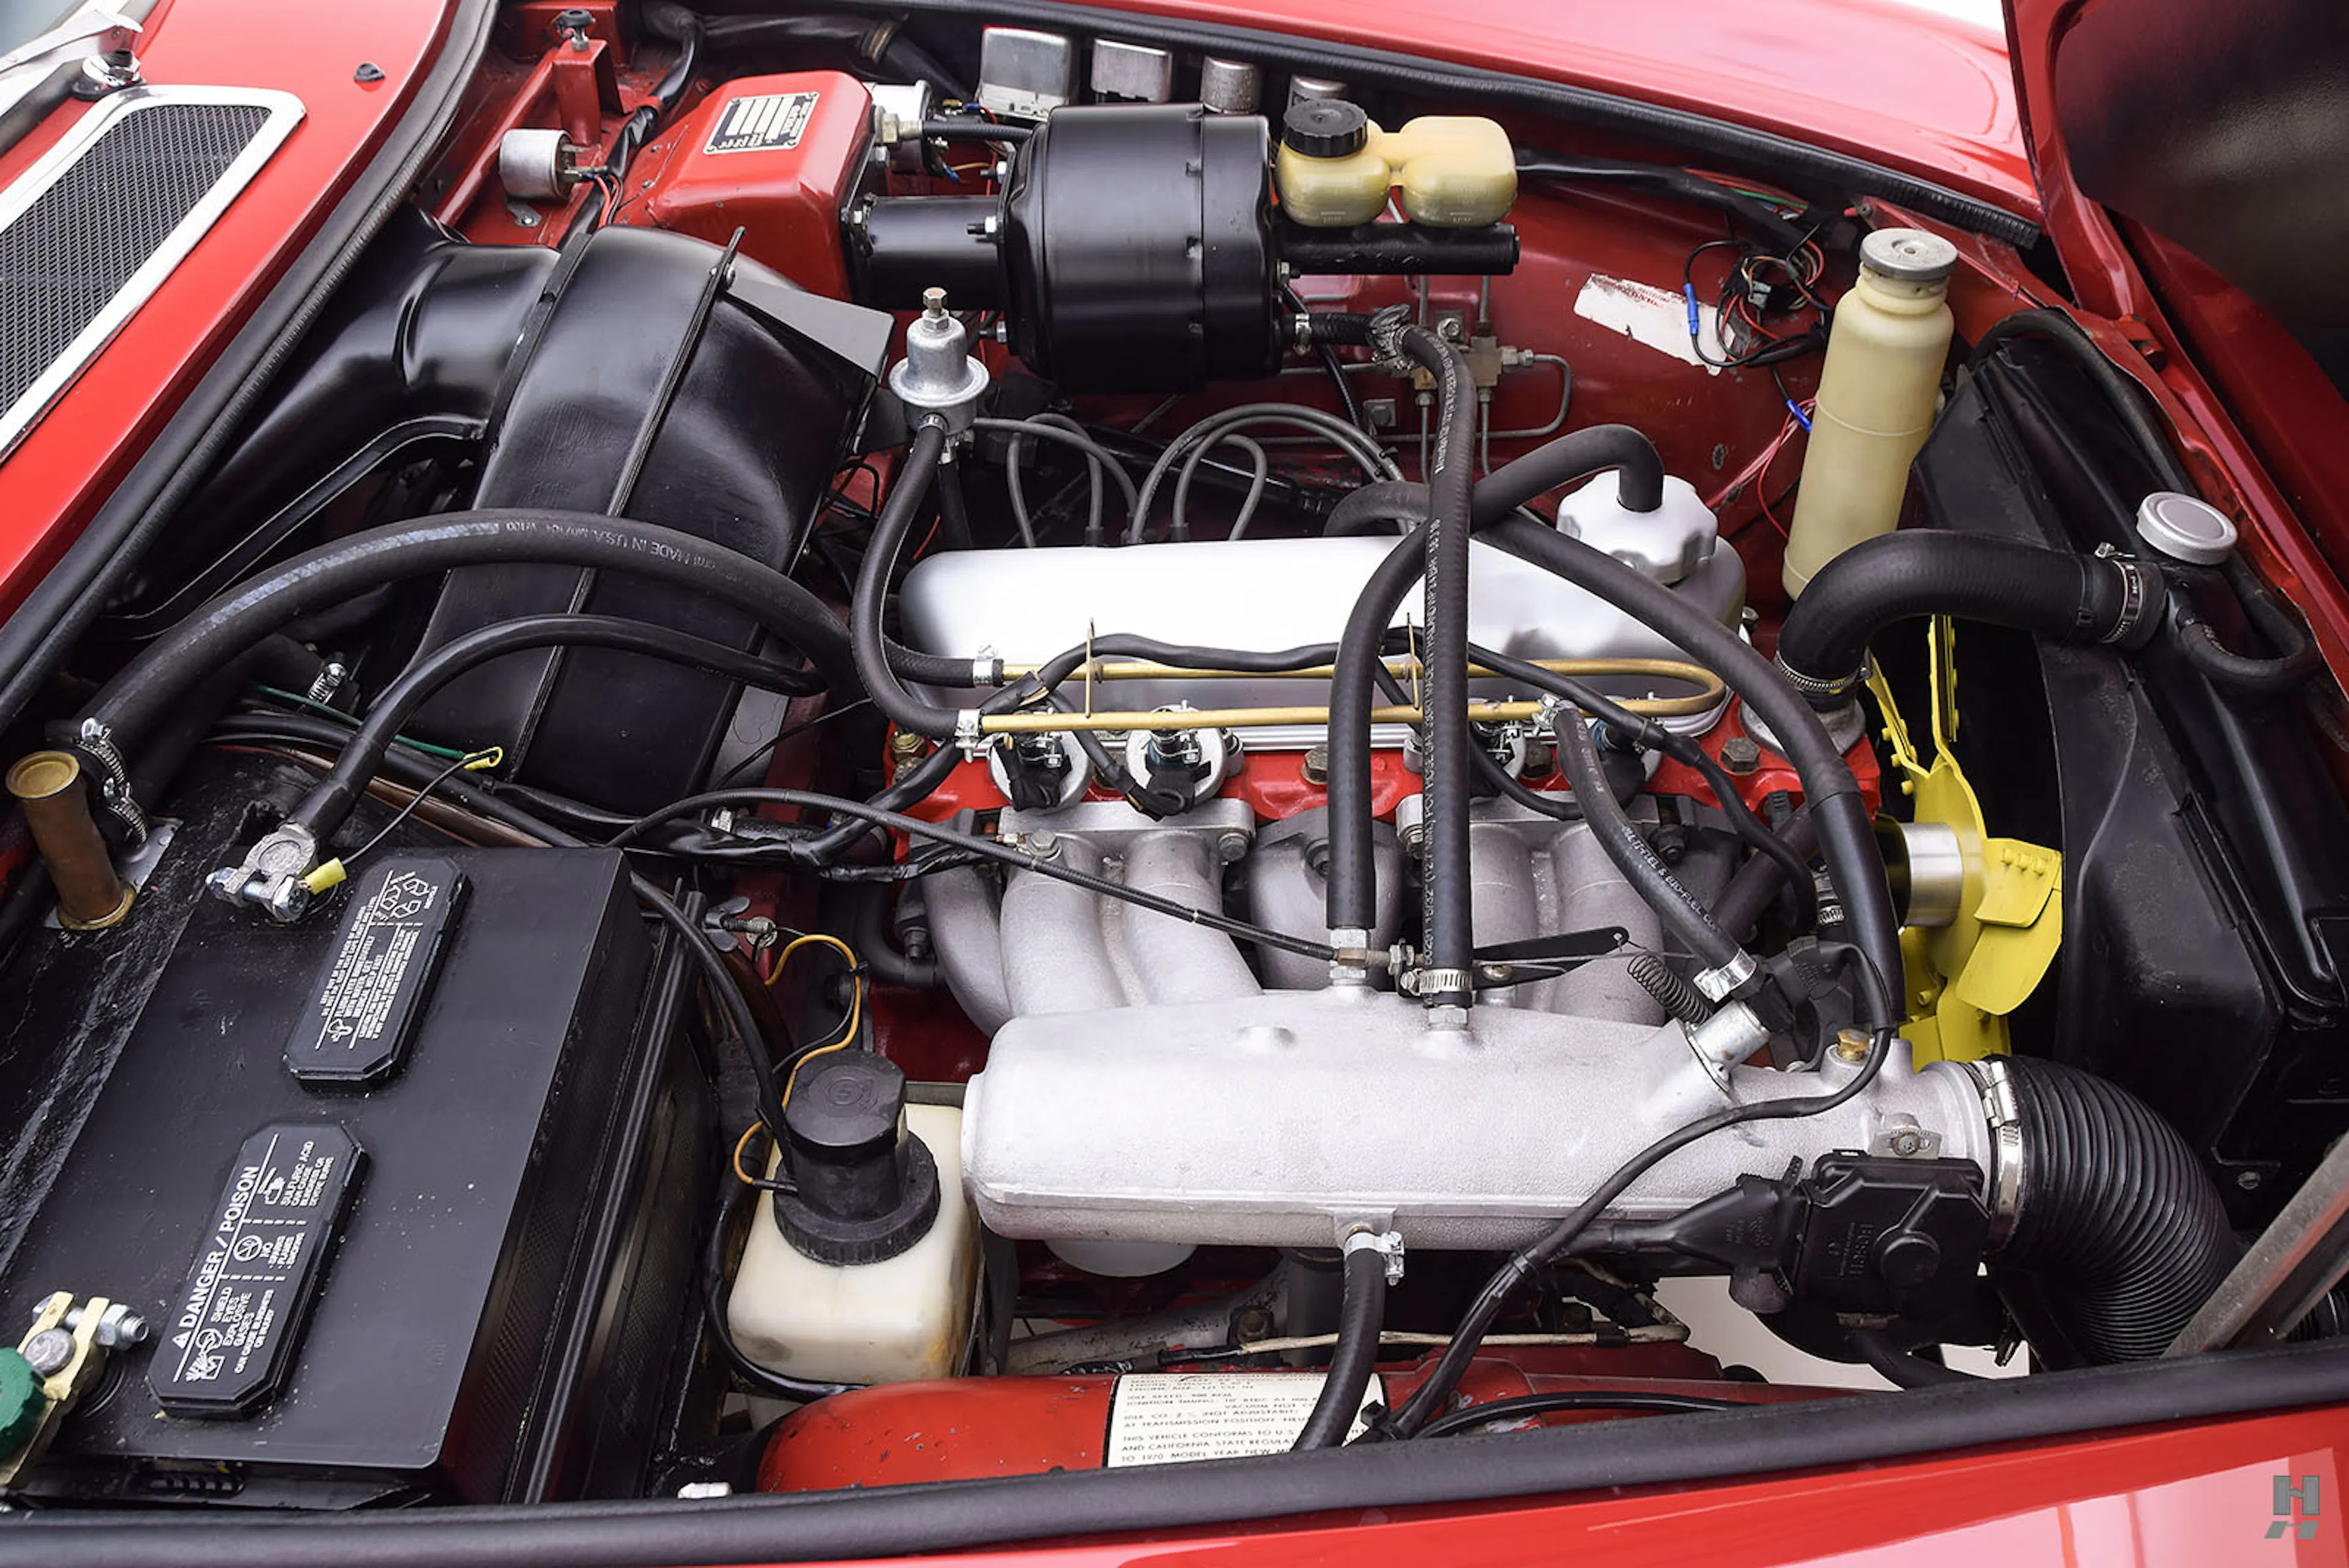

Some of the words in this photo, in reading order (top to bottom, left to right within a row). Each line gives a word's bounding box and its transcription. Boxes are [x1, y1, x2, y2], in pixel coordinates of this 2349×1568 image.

[280, 1164, 306, 1205] SULFURIC
[298, 1140, 315, 1161] ACID
[178, 1251, 225, 1327] DANGER
[218, 1166, 260, 1231] POISON
[259, 1243, 274, 1257] NO
[210, 1286, 234, 1321] SHIELD
[221, 1296, 240, 1321] EYES
[221, 1292, 253, 1345] EXPLOSIVE
[233, 1312, 256, 1345] GASES
[1148, 1441, 1210, 1450] CALIFORNIA
